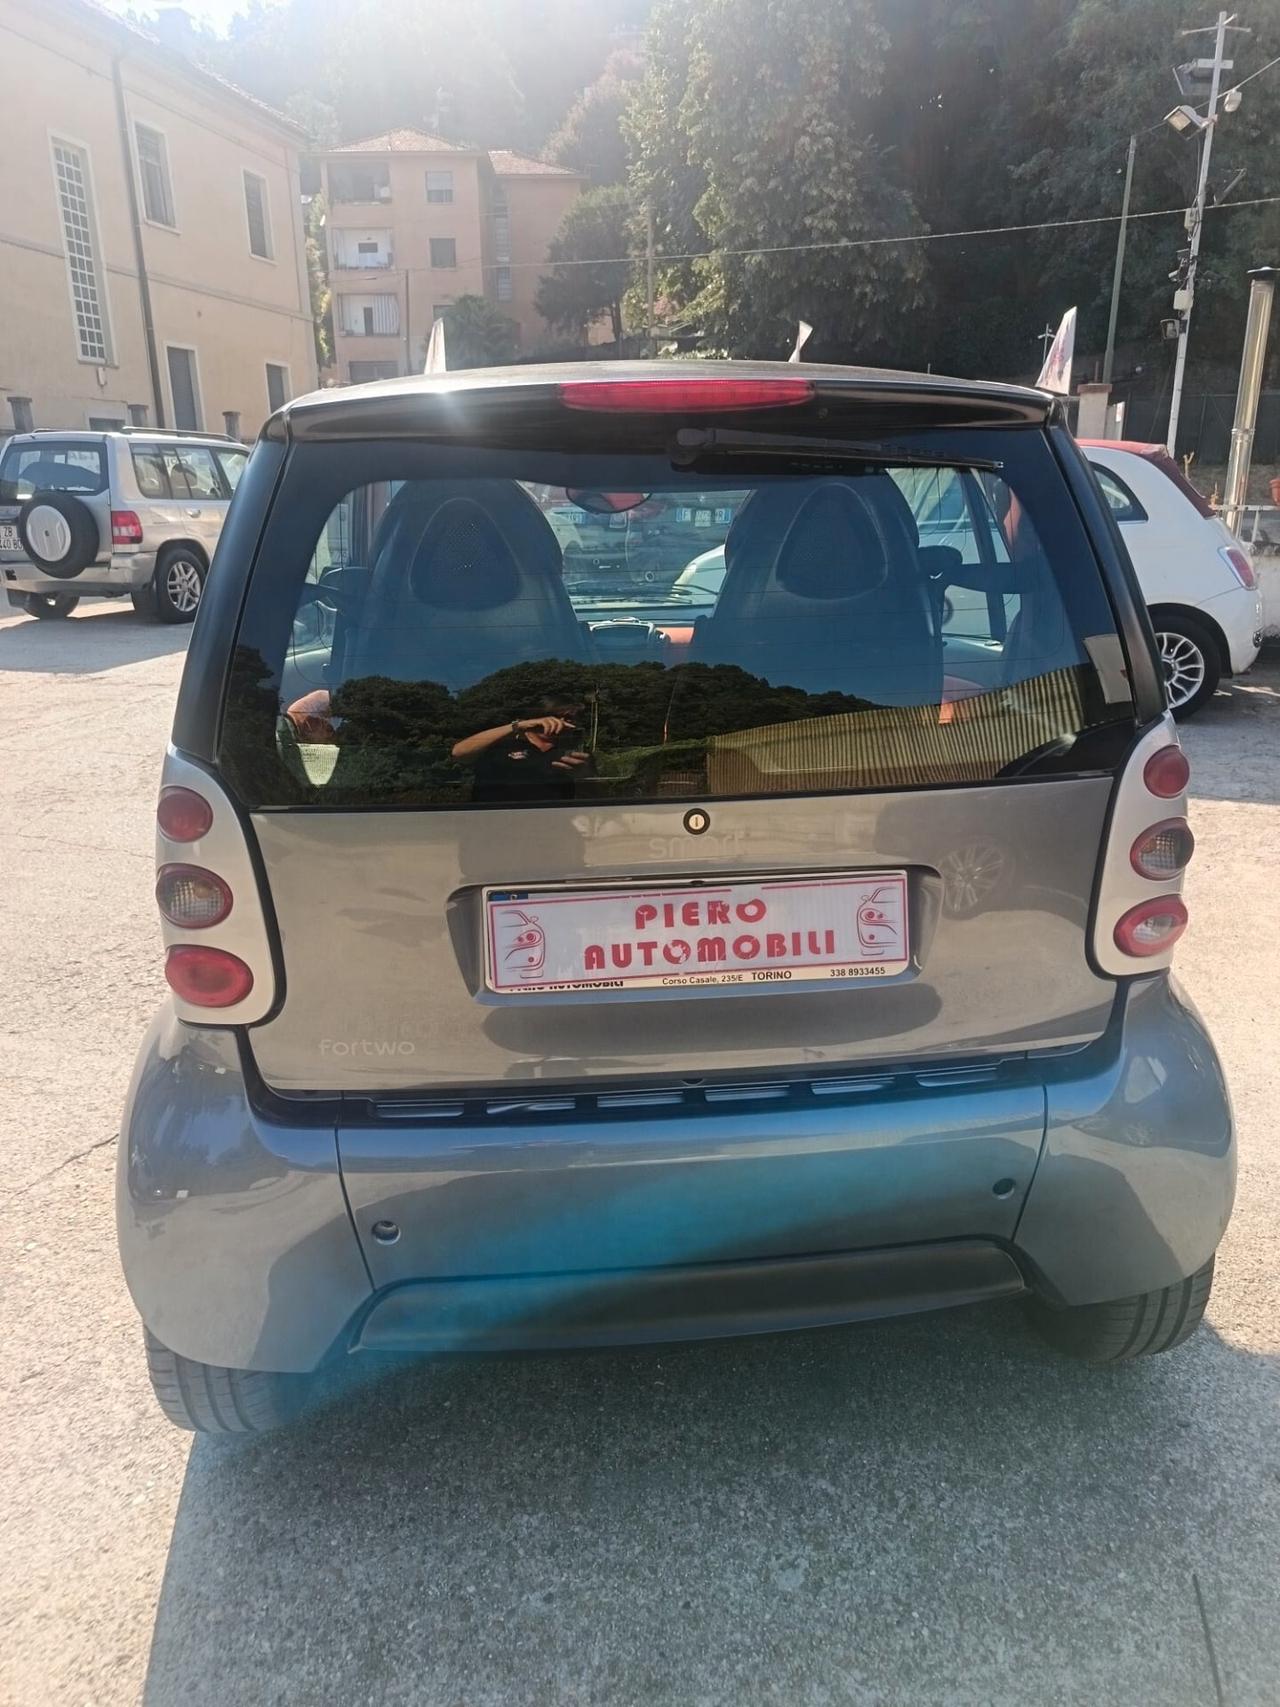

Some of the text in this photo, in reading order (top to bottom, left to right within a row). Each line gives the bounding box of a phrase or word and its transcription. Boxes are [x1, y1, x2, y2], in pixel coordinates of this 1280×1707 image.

[635, 899, 766, 929] PIERO
[585, 932, 835, 970] AUTOMOBILI
[662, 976, 688, 986] Corso
[689, 975, 720, 985] Casale,
[752, 970, 793, 981] TORINO
[830, 966, 886, 977] 338 8933455
[318, 1038, 416, 1057] fortwo
